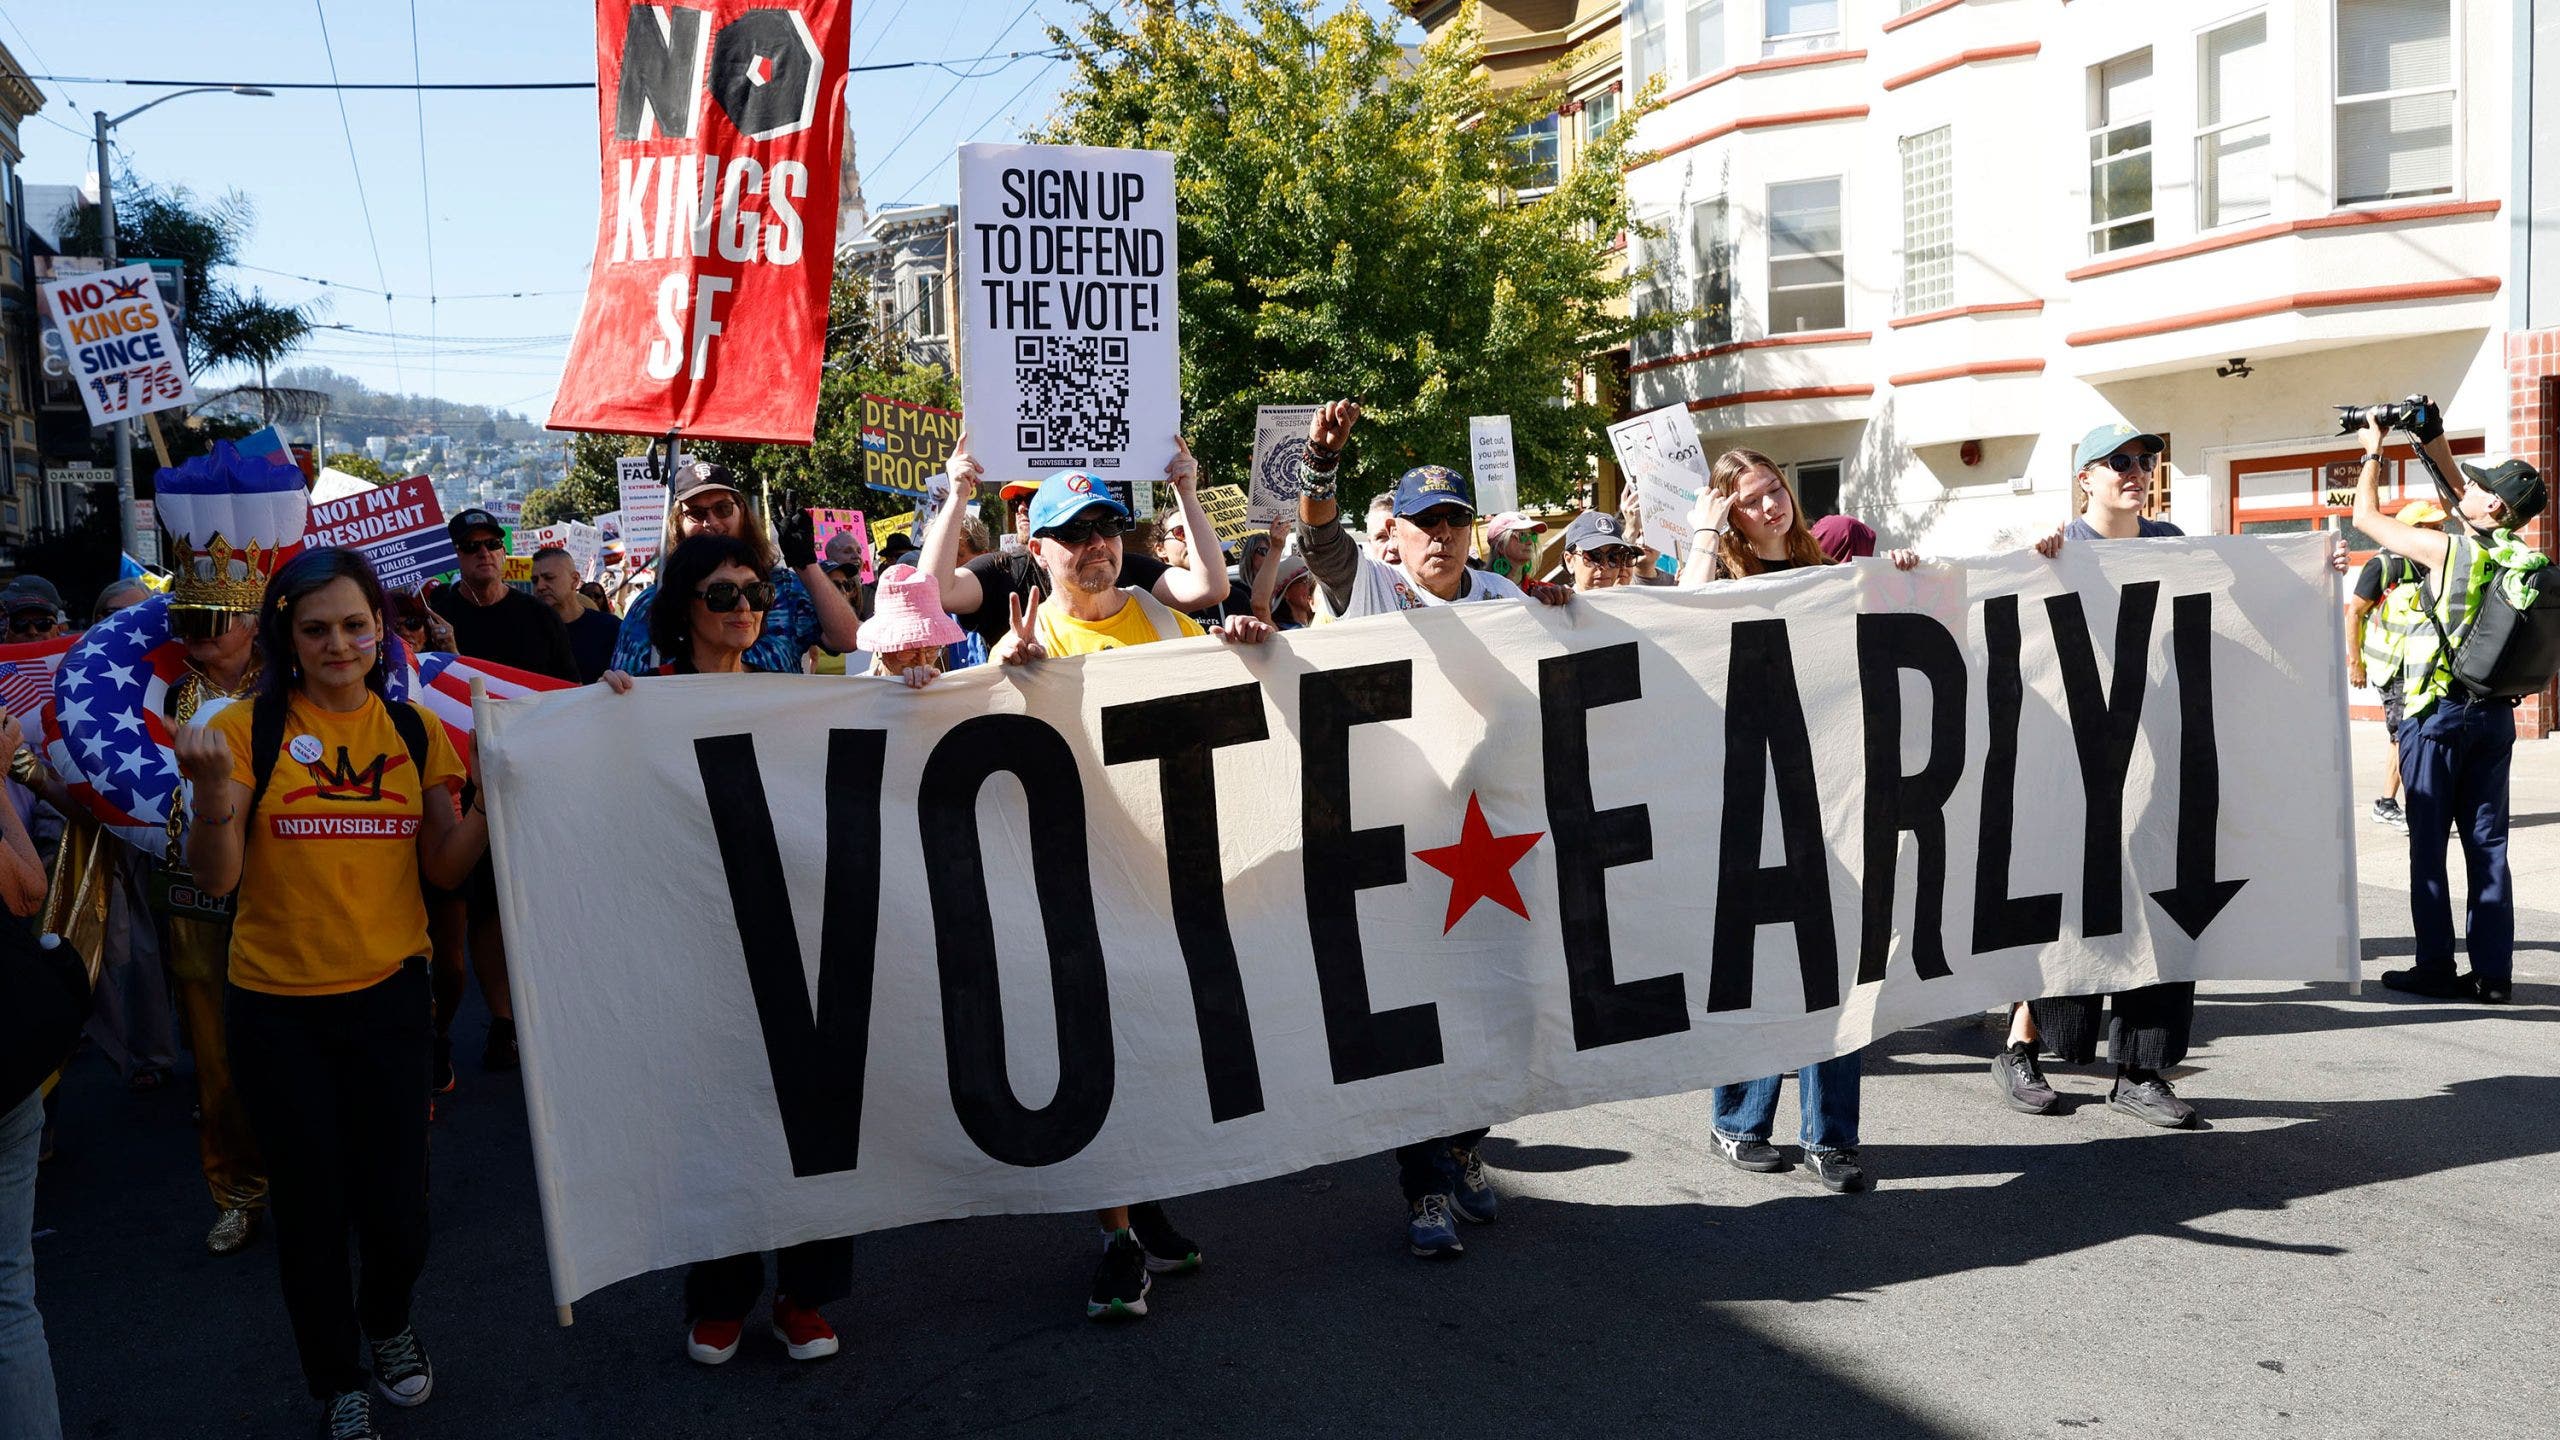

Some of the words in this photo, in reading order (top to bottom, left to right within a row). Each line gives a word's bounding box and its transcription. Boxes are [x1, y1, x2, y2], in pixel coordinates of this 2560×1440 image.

[615, 4, 824, 142] NO
[612, 155, 808, 265] KINGS
[1002, 168, 1088, 220] SIGN
[1097, 171, 1144, 221] UP
[974, 223, 1021, 274] TO
[1030, 225, 1164, 277] DEFEND
[57, 283, 104, 316] NO
[981, 280, 1051, 330] THE
[1060, 281, 1159, 332] VOTE!
[67, 303, 159, 345] KINGS
[647, 272, 733, 380] SF
[79, 333, 165, 374] SINCE
[90, 361, 183, 414] 1776
[866, 400, 957, 441] DEMAN
[1479, 436, 1493, 445] Get
[887, 432, 951, 461] DUE
[1478, 451, 1491, 460] you
[50, 471, 112, 480] OAKWOOD
[2333, 466, 2346, 476] NO
[312, 497, 360, 527] NOT
[365, 485, 400, 512] MY
[485, 501, 502, 512] VOTE
[1215, 486, 1238, 499] THE
[303, 503, 424, 550] PRESIDENT
[379, 541, 407, 556] VOICE
[381, 555, 416, 573] VALUES
[386, 570, 422, 589] BELIEFS
[277, 818, 397, 835] INDIVISIBLE
[400, 820, 418, 835] SF
[695, 660, 1445, 1175] VOTE
[1540, 582, 2160, 1050] EARLY
